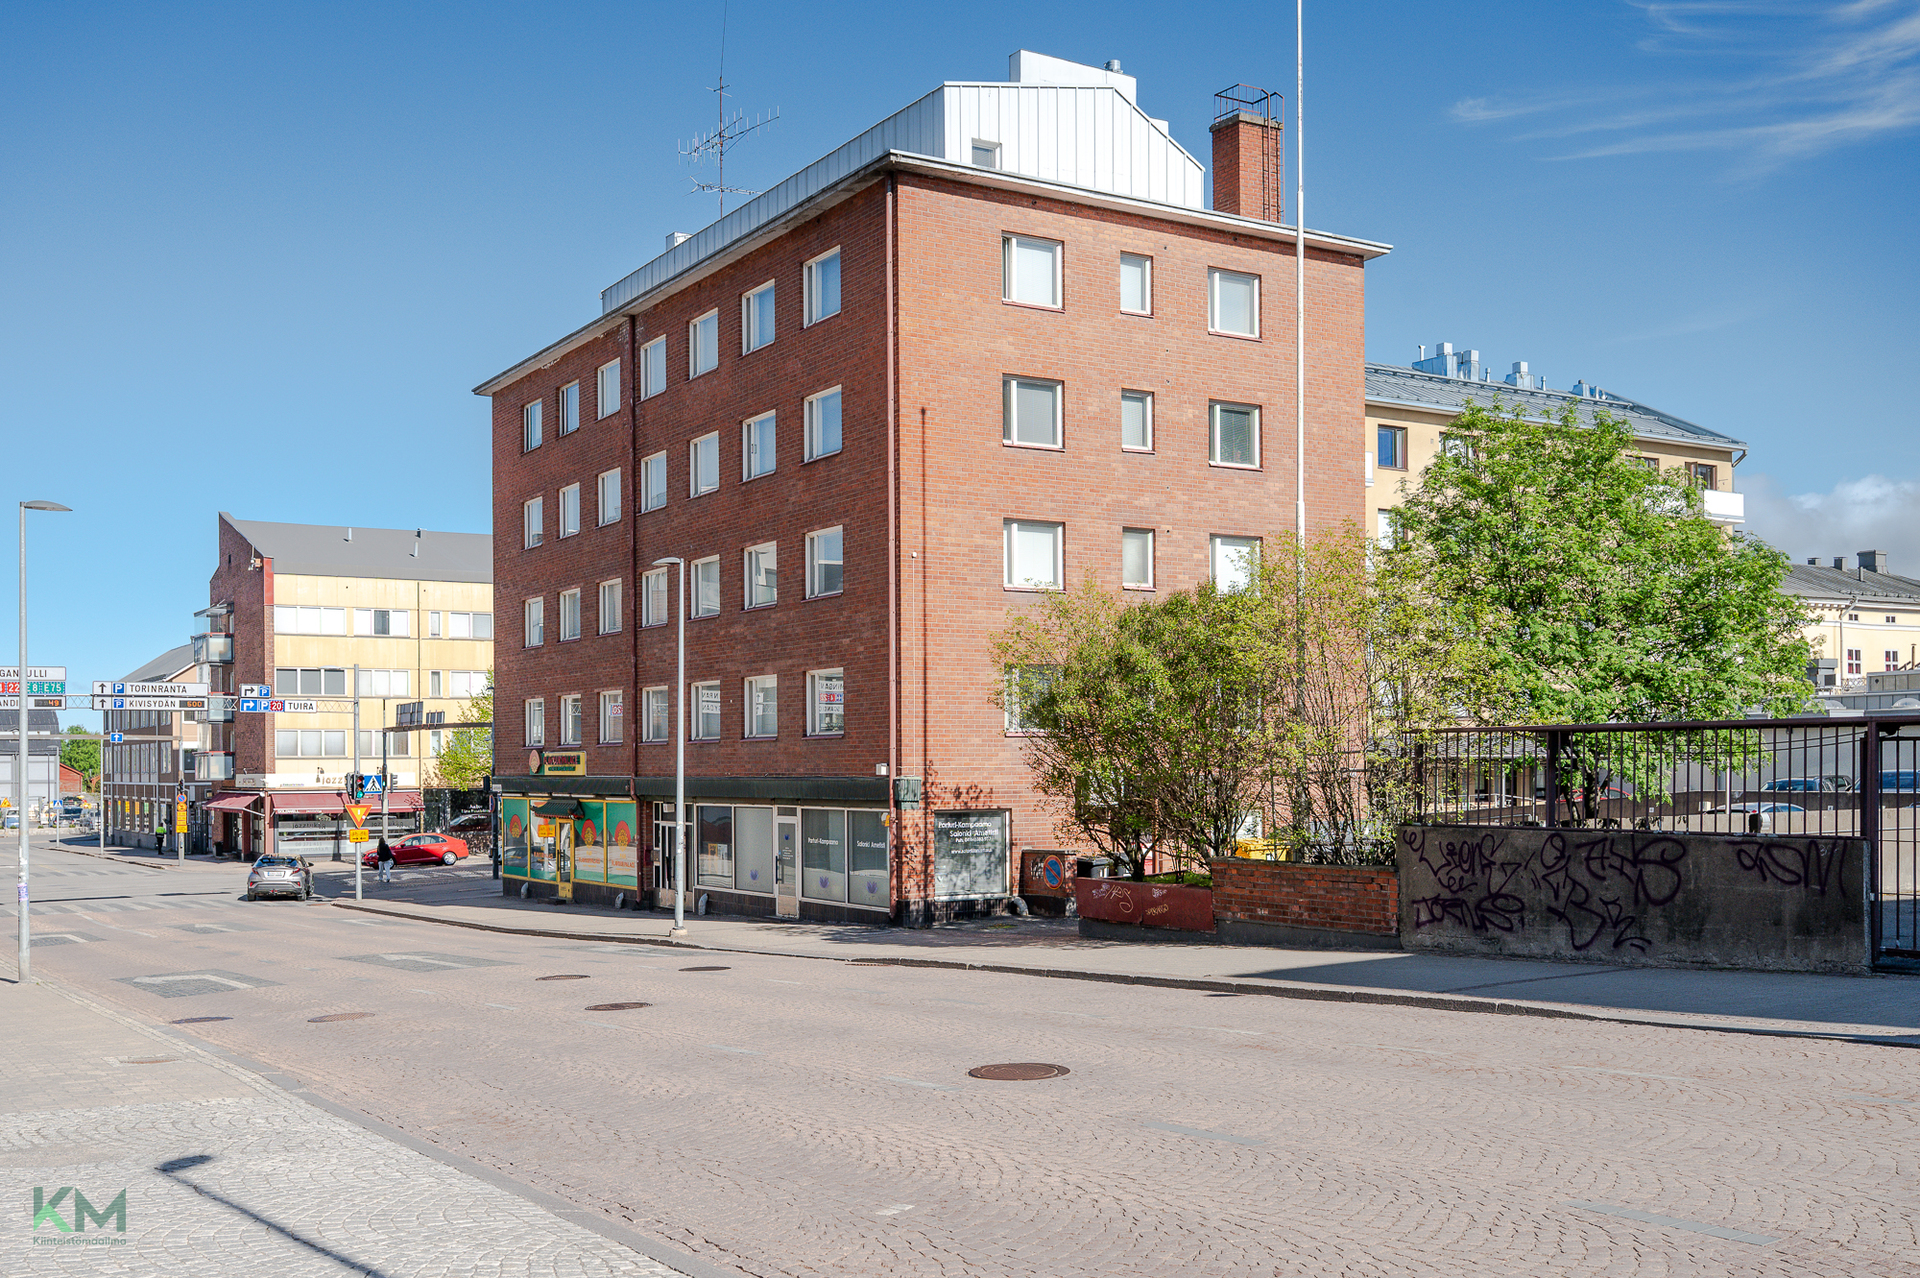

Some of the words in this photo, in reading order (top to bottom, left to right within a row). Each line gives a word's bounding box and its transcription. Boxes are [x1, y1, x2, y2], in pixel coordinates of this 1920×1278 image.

[129, 684, 187, 693] TORINRANTA
[129, 699, 176, 708] KIVISYDÄN
[288, 702, 314, 710] TUIRA
